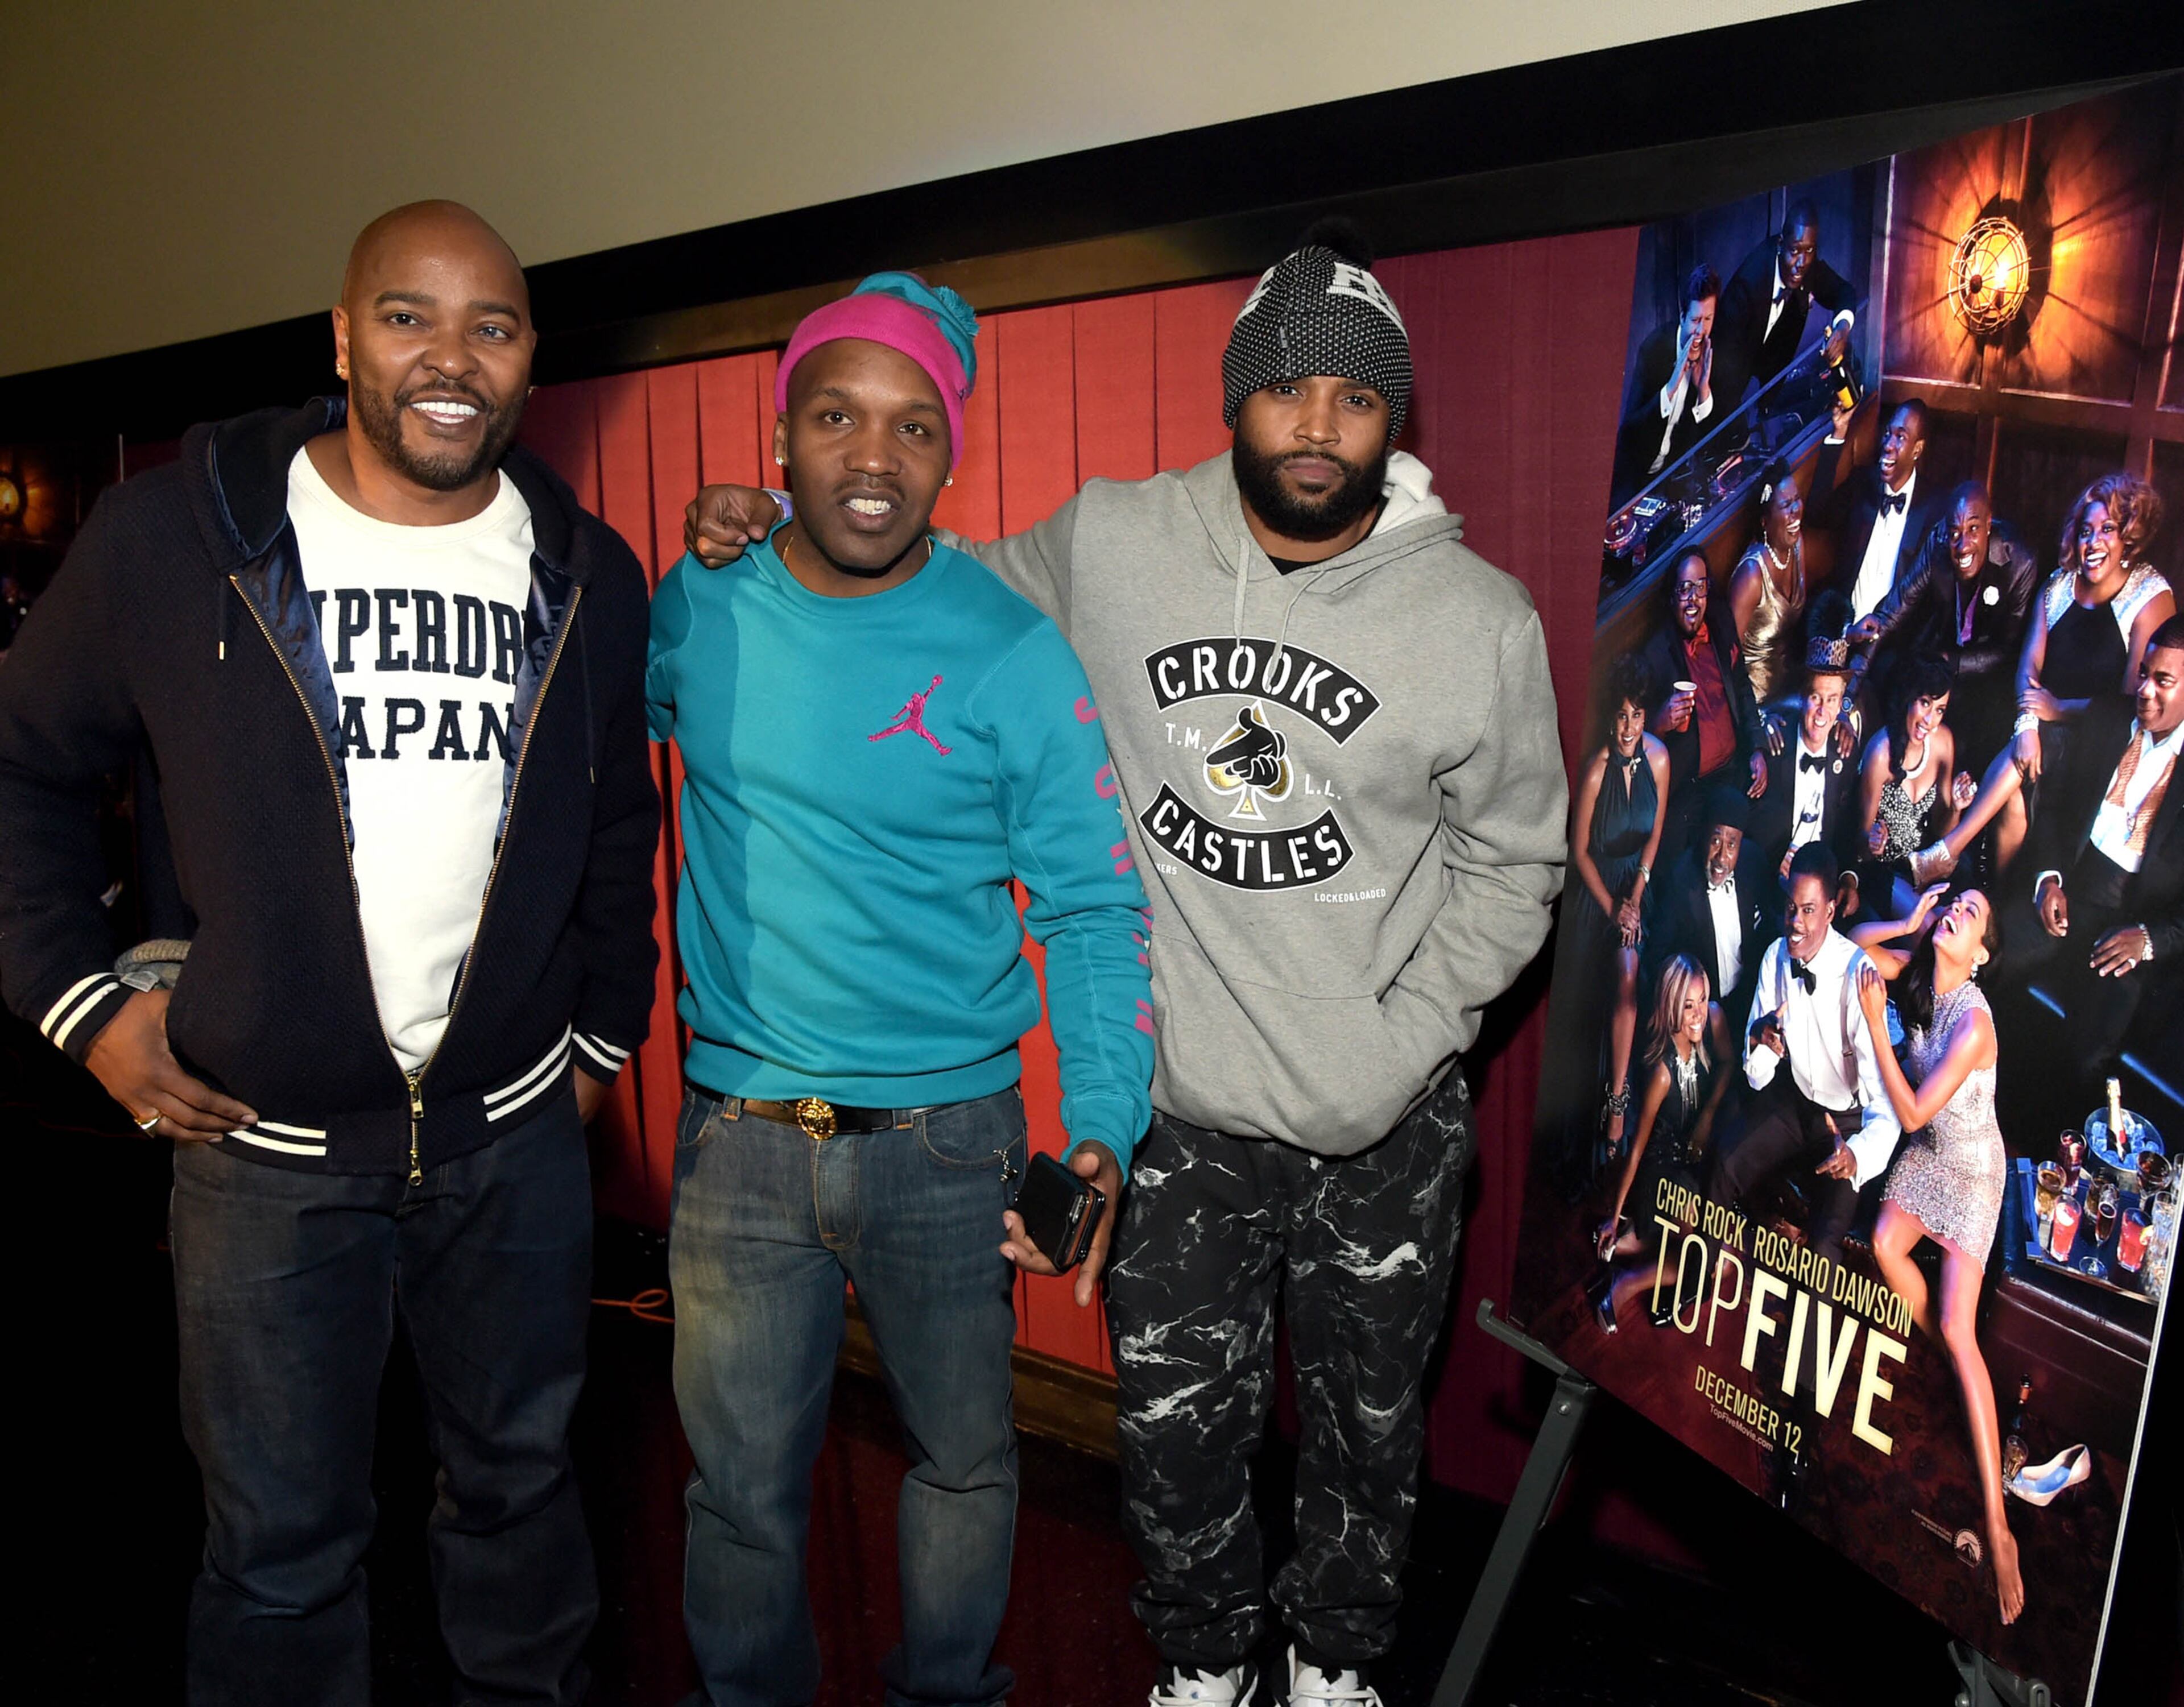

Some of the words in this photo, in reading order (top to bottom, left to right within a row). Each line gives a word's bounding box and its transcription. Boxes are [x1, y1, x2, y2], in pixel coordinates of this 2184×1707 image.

[308, 589, 523, 686] PERDR
[1157, 645, 1363, 726] CROOKS
[1165, 723, 1207, 751] T.M.
[1305, 774, 1341, 800] L.L.
[1152, 799, 1342, 882] CASTLES
[1314, 888, 1386, 904] LOCKED&LOADED
[1656, 1178, 1701, 1227] CHRIS
[1703, 1200, 1747, 1251] ROCK
[1753, 1227, 1829, 1294] ROSARIO
[1833, 1266, 1914, 1338] DAWSON
[1652, 1215, 1744, 1346] TOP
[1740, 1268, 1908, 1456] FIVE
[1695, 1365, 1779, 1440] DECEMBER
[1785, 1422, 1801, 1453] 12
[1710, 1403, 1773, 1452] TopFiveMovie.com
